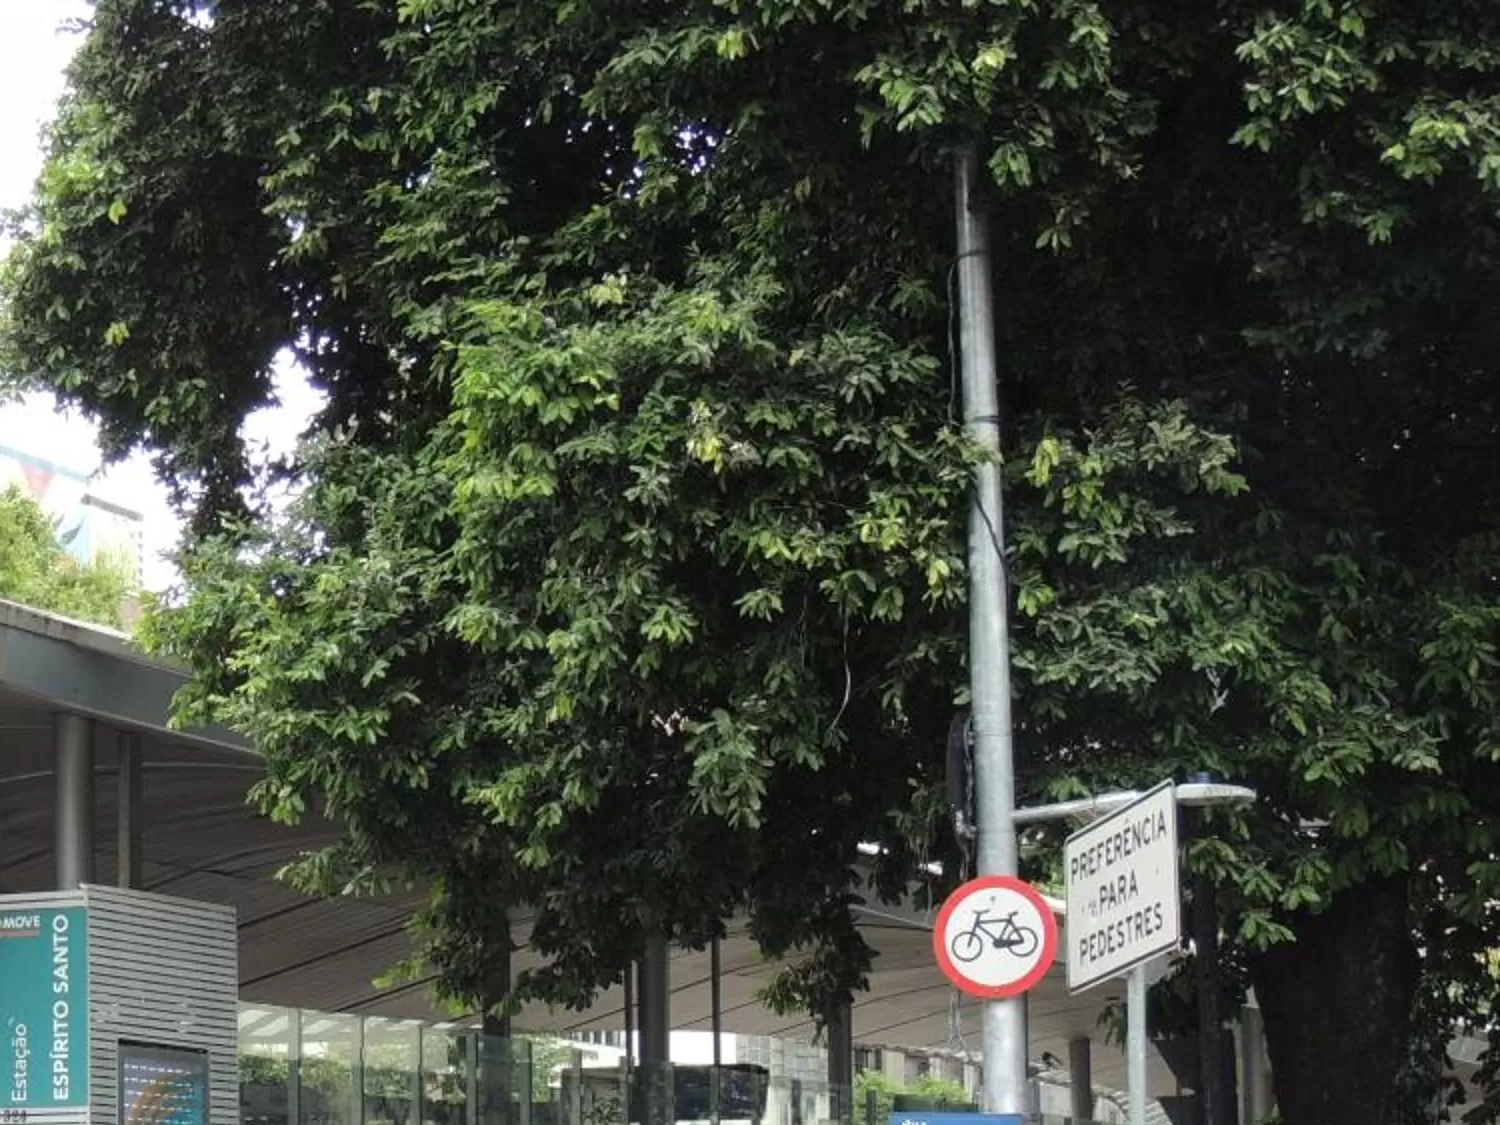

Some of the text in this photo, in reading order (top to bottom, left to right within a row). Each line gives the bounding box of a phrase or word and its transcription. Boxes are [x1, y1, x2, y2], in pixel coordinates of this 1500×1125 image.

[1071, 808, 1167, 886] PREFERÊNCIA
[3, 915, 41, 929] MOVE
[1100, 868, 1139, 915] PARA
[1079, 902, 1163, 966] PEDESTRES
[49, 914, 69, 1100] ESPÍRITO SANTO
[11, 1023, 31, 1102] Estação
